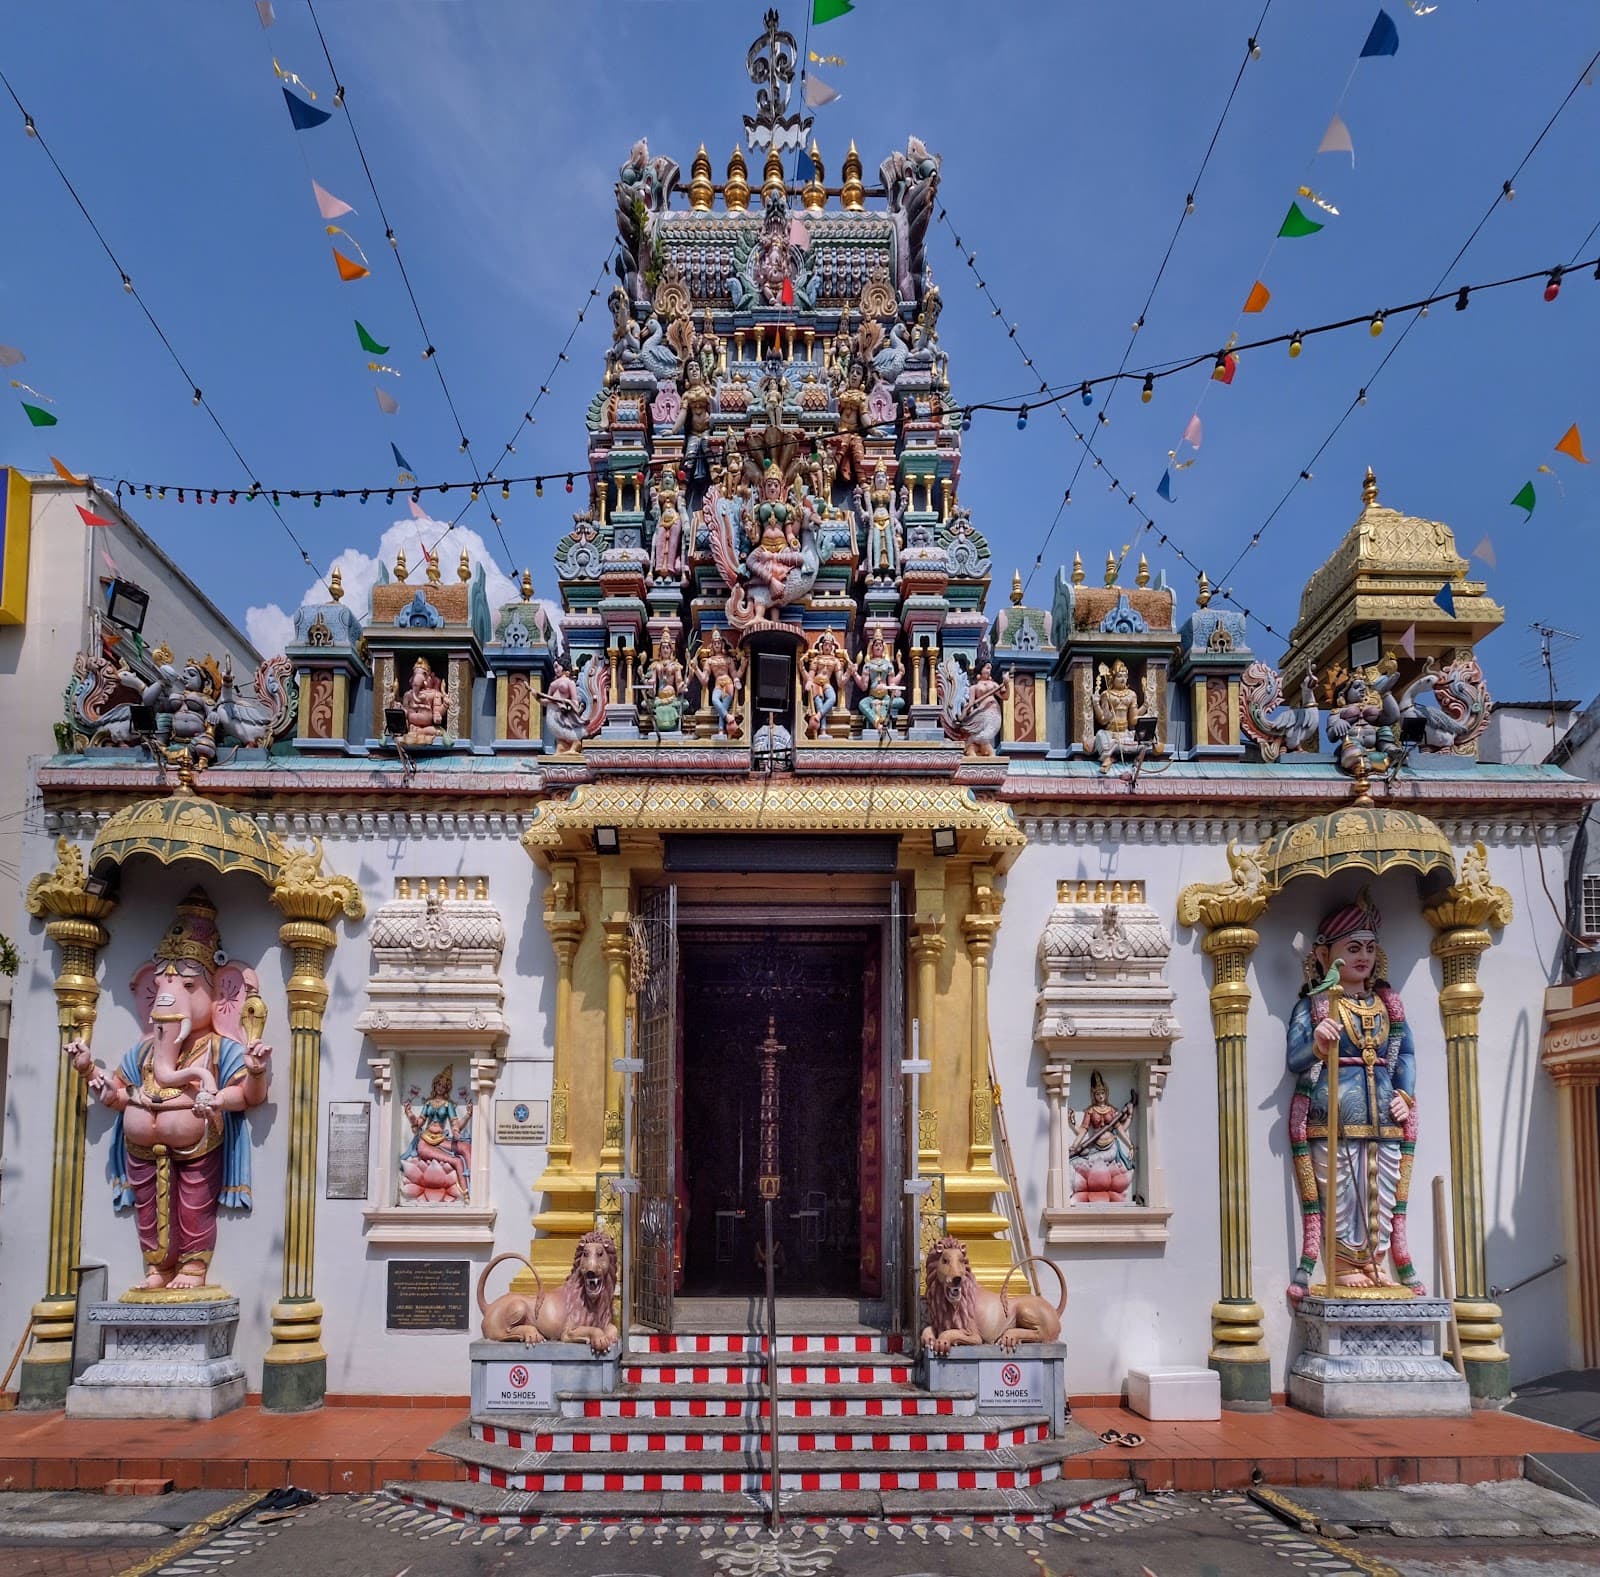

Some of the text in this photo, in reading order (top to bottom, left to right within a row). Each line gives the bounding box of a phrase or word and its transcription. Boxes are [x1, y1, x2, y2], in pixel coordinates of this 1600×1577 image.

[501, 1391, 536, 1399] NO SHOES
[994, 1389, 1029, 1397] NO SHOES
